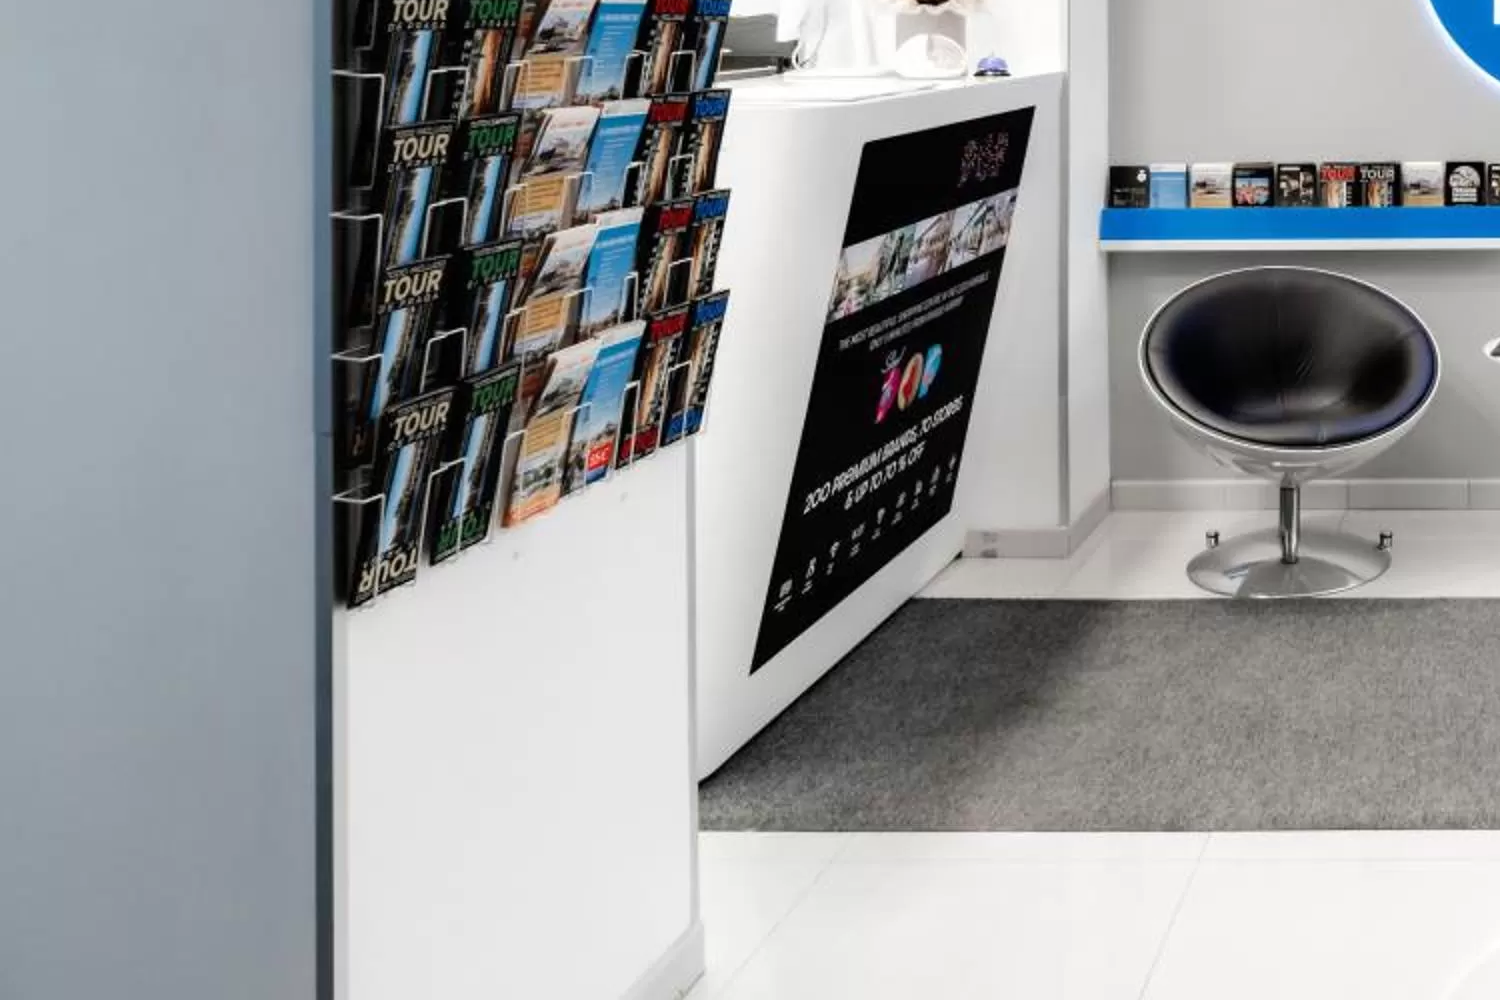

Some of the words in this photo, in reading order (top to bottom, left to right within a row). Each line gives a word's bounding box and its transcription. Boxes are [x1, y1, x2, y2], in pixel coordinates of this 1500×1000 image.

[469, 0, 519, 22] TOUR
[393, 133, 450, 164] TOUR
[468, 123, 517, 154] TOUR
[471, 249, 520, 280] TOUR
[384, 269, 443, 304] TOUR
[393, 401, 450, 441] TOUR
